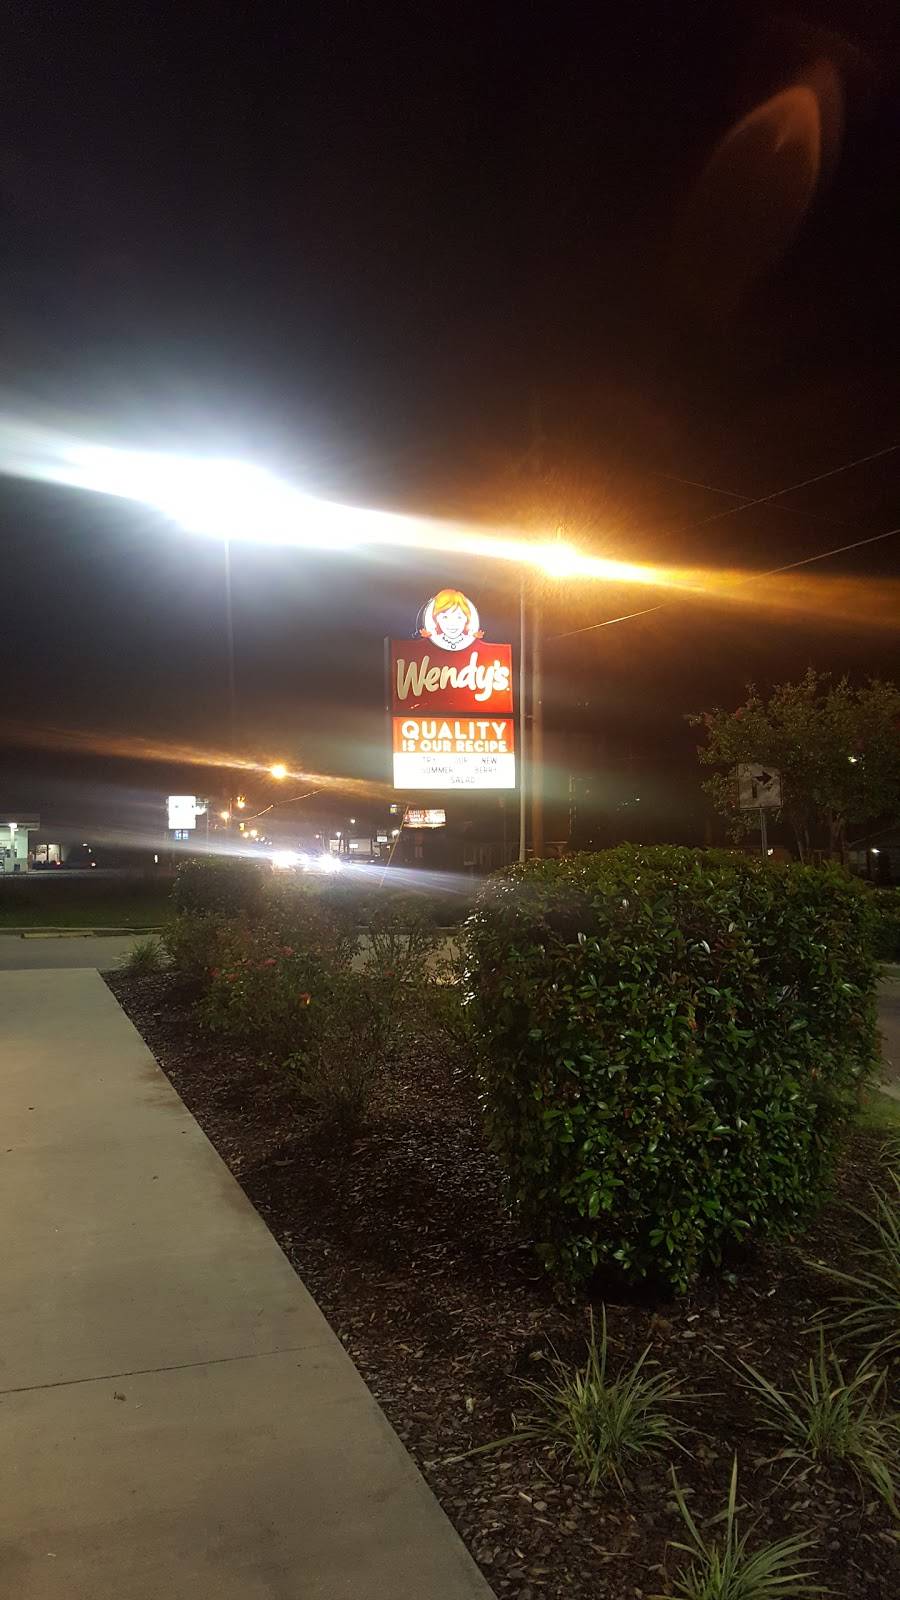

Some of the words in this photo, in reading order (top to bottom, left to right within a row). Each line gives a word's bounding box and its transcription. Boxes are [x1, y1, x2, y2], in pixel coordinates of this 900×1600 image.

[396, 652, 510, 702] Wendy's
[401, 720, 507, 740] QUALITY
[401, 740, 416, 752] IS
[420, 740, 452, 752] OUR
[456, 741, 507, 753] RECIPE
[480, 756, 497, 765] NEW
